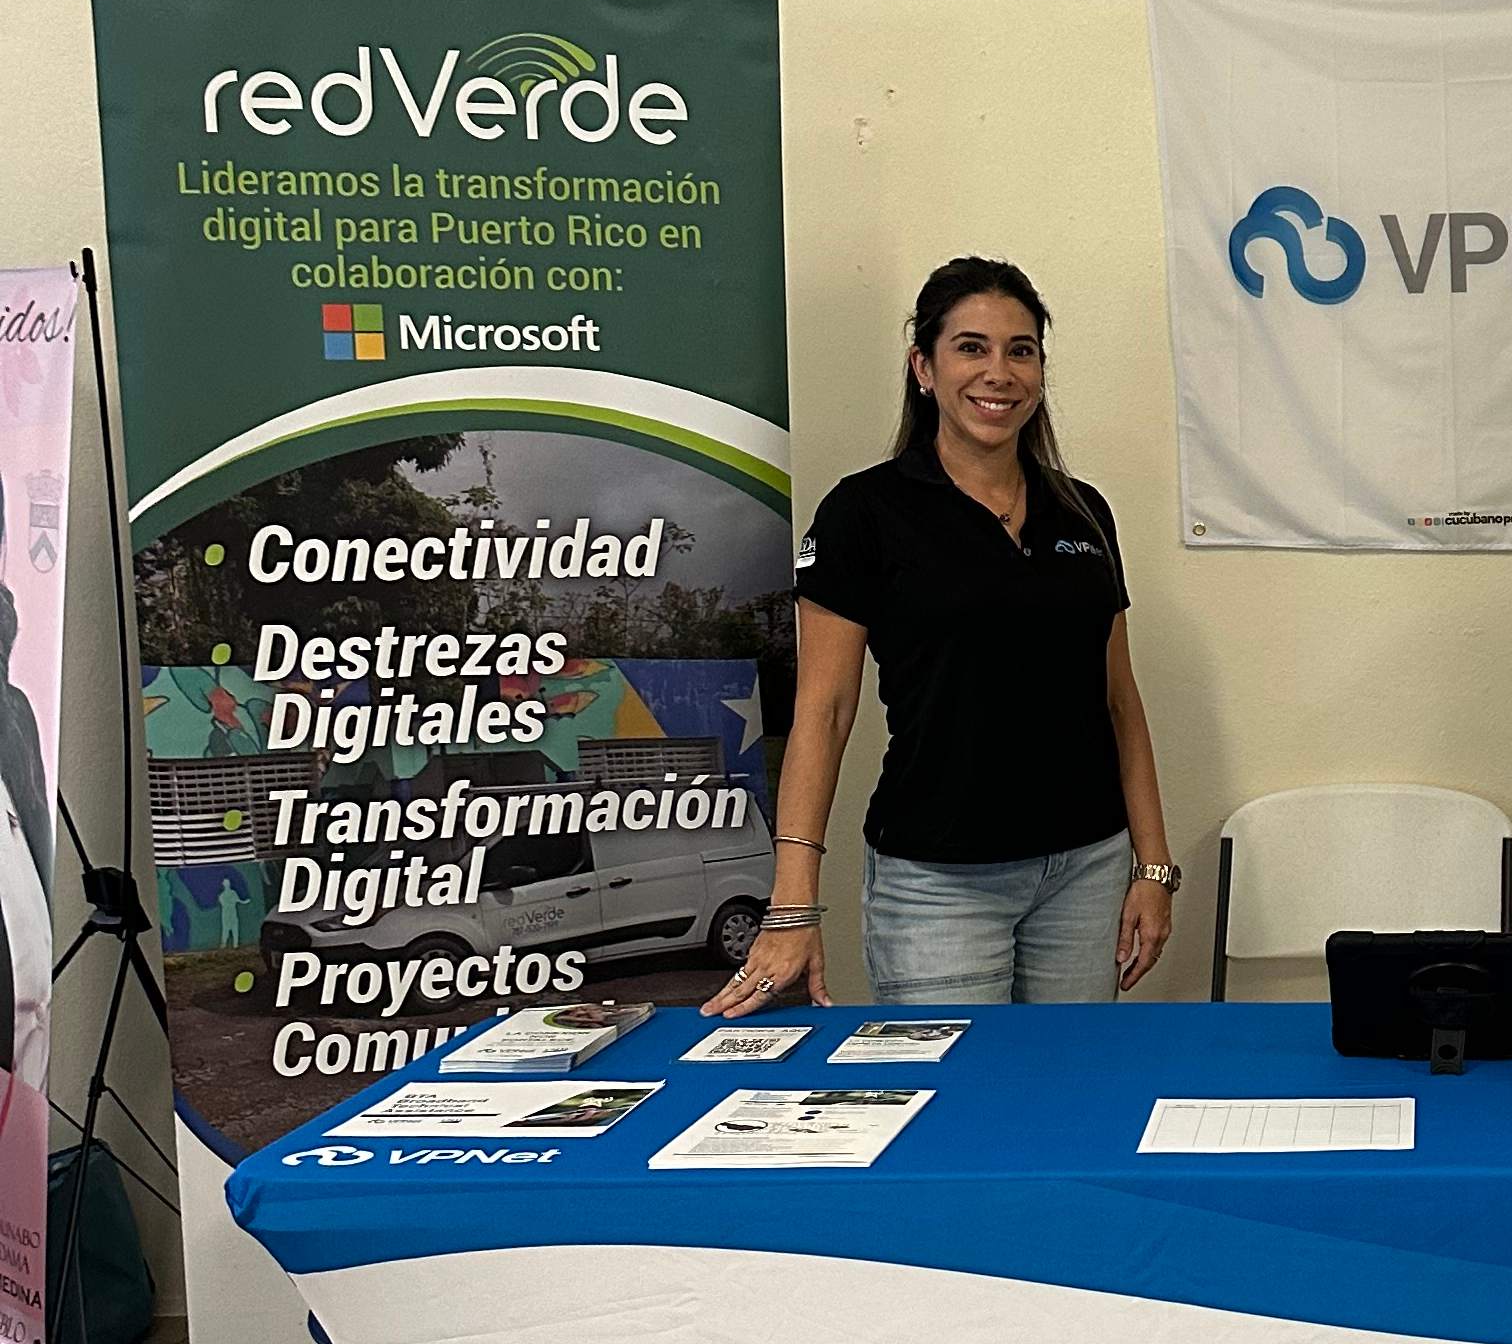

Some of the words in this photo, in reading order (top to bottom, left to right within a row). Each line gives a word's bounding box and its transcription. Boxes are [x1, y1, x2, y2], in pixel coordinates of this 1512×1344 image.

[203, 46, 689, 146] redVerde
[177, 160, 380, 199] Lideramos
[392, 163, 424, 199] la
[435, 167, 721, 204] transformación
[203, 207, 322, 250] digital
[335, 219, 418, 250] para
[431, 213, 556, 248] Puerto
[568, 214, 648, 248] Rico
[659, 224, 702, 249] en
[291, 254, 535, 290] colaboración
[546, 265, 624, 291] con:
[399, 314, 600, 352] Microsoft
[247, 518, 665, 585] Conectividad
[254, 624, 568, 683] Destrezas
[267, 685, 547, 764] Digitales
[268, 772, 749, 847] Transformación
[277, 845, 486, 927] Digital
[275, 945, 587, 1017] Proyectos
[389, 1148, 562, 1164] VPNet
